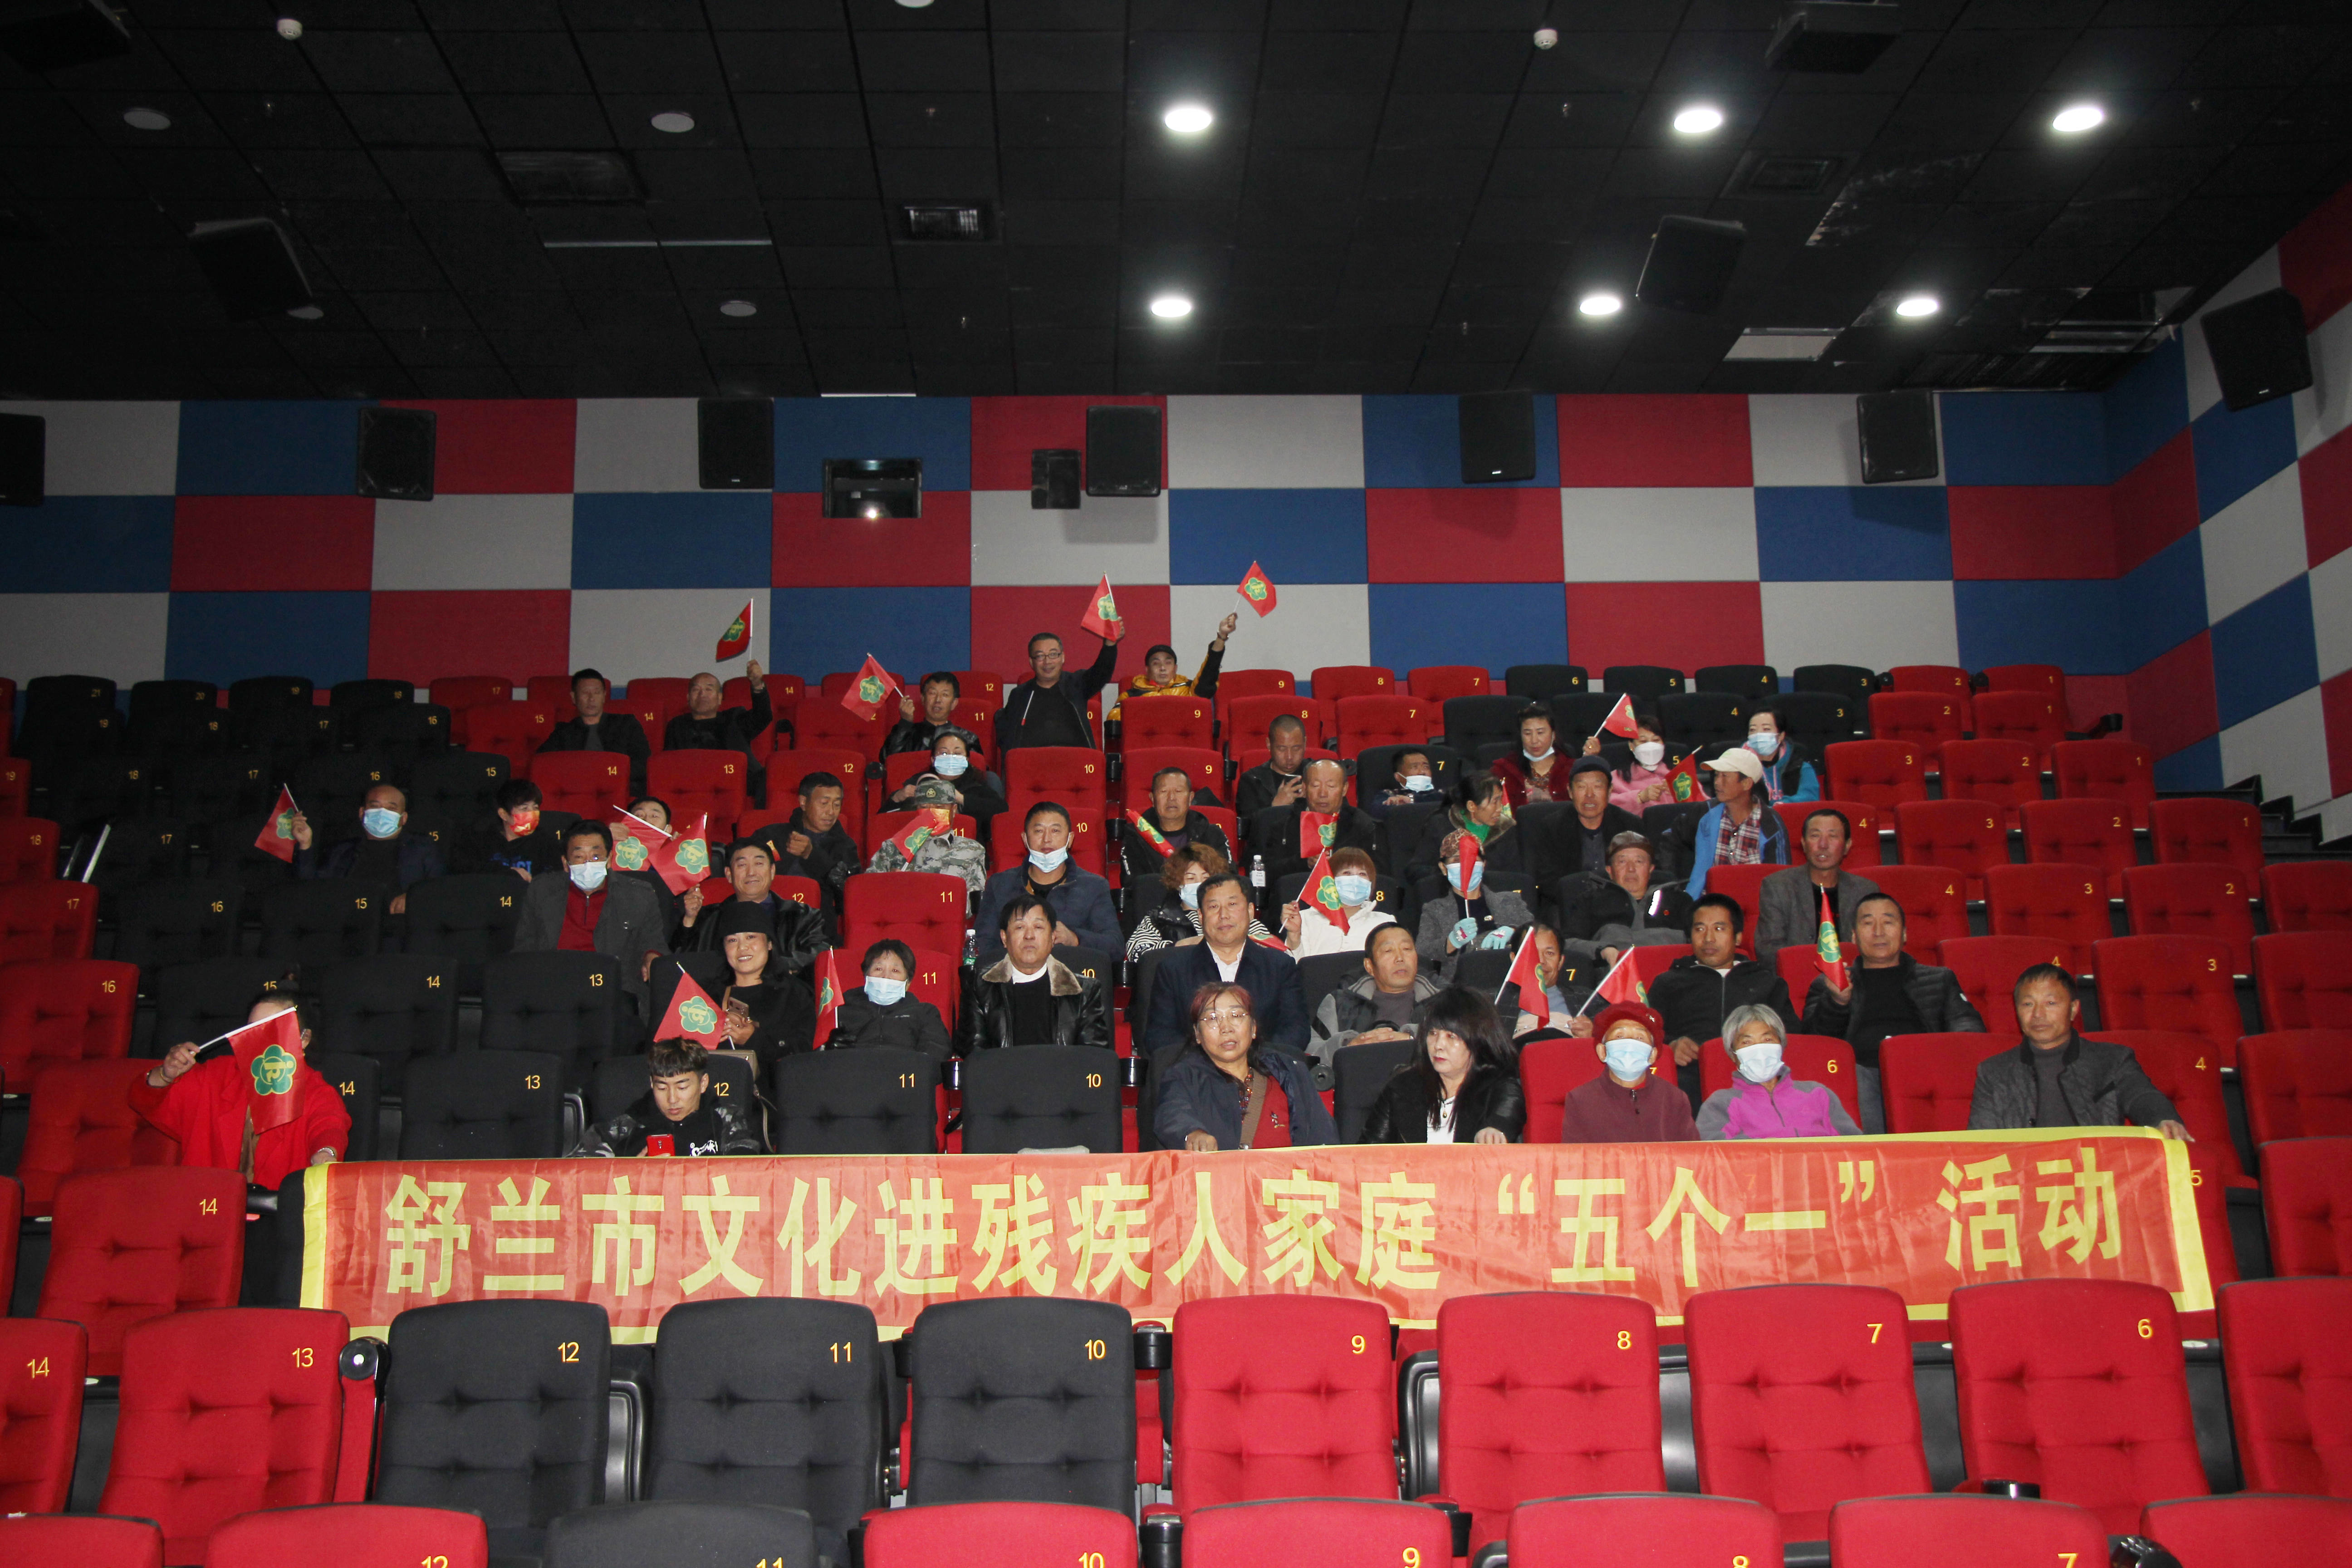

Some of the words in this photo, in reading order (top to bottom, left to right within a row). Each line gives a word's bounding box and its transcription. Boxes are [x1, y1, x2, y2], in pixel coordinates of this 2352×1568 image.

[1378, 677, 1384, 686] 8
[1474, 678, 1480, 686] 7
[1572, 677, 1579, 685] 6
[1670, 678, 1676, 686] 5
[1862, 678, 1867, 686] 3
[1955, 678, 1962, 686] 2
[985, 683, 994, 691] 12
[1195, 710, 1201, 718] 9
[1302, 710, 1308, 719] 8
[1410, 710, 1416, 718] 7
[1838, 709, 1844, 717] 3
[1944, 706, 1951, 715] 2
[2047, 705, 2053, 714] 1
[428, 716, 438, 725] 16
[535, 714, 545, 723] 15
[645, 713, 654, 721] 14
[975, 712, 985, 721] 11
[1087, 711, 1094, 720] 0
[319, 720, 329, 729] 17
[1673, 756, 1681, 765] 5
[1906, 755, 1913, 765] 3
[2022, 757, 2029, 767] 2
[2136, 757, 2142, 766] 1
[608, 766, 617, 775] 14
[724, 764, 735, 774] 13
[844, 764, 854, 773] 12
[1084, 764, 1095, 774] 10
[1205, 765, 1213, 774] 9
[1437, 761, 1445, 771] 7
[6, 771, 16, 781] 19
[129, 770, 139, 779] 18
[249, 770, 259, 779] 17
[371, 771, 381, 781] 16
[486, 767, 497, 777] 15
[1859, 818, 1867, 828] 4
[1986, 818, 1994, 829] 3
[2113, 817, 2122, 828] 2
[2244, 817, 2249, 827] 1
[1077, 823, 1088, 833] 10
[30, 835, 42, 845] 18
[162, 834, 173, 844] 17
[556, 830, 561, 840] 1
[1945, 885, 1955, 896] 4
[2085, 883, 2093, 894] 3
[2226, 883, 2235, 895] 2
[792, 893, 804, 904] 12
[941, 892, 953, 903] 11
[1376, 890, 1385, 902] 8
[67, 898, 80, 909] 17
[211, 901, 224, 912] 16
[356, 898, 368, 909] 15
[500, 897, 512, 907] 14
[2052, 956, 2061, 967] 4
[2208, 959, 2217, 971] 3
[923, 972, 936, 985] 11
[1567, 969, 1576, 981] 7
[264, 981, 277, 990] 15
[427, 976, 441, 988] 14
[590, 974, 603, 987] 13
[102, 980, 116, 993] 16
[1828, 1060, 1838, 1073] 6
[2195, 1057, 2207, 1071] 4
[525, 1075, 541, 1089] 13
[899, 1073, 915, 1088] 11
[1086, 1074, 1102, 1088] 10
[339, 1081, 356, 1096] 14
[714, 1083, 729, 1097] 12
[2190, 1169, 2202, 1186] 5
[200, 1198, 218, 1215] 14
[1867, 1323, 1883, 1344] 7
[2138, 1318, 2153, 1339] 6
[1352, 1335, 1367, 1355] 9
[1617, 1331, 1632, 1350] 8
[558, 1342, 579, 1362] 12
[830, 1342, 852, 1363] 11
[1085, 1340, 1106, 1360] 10
[292, 1348, 314, 1368] 13
[27, 1357, 50, 1378] 14
[1078, 1553, 1105, 1568] 10
[1402, 1547, 1421, 1568] 9
[2058, 1553, 2078, 1568] 7
